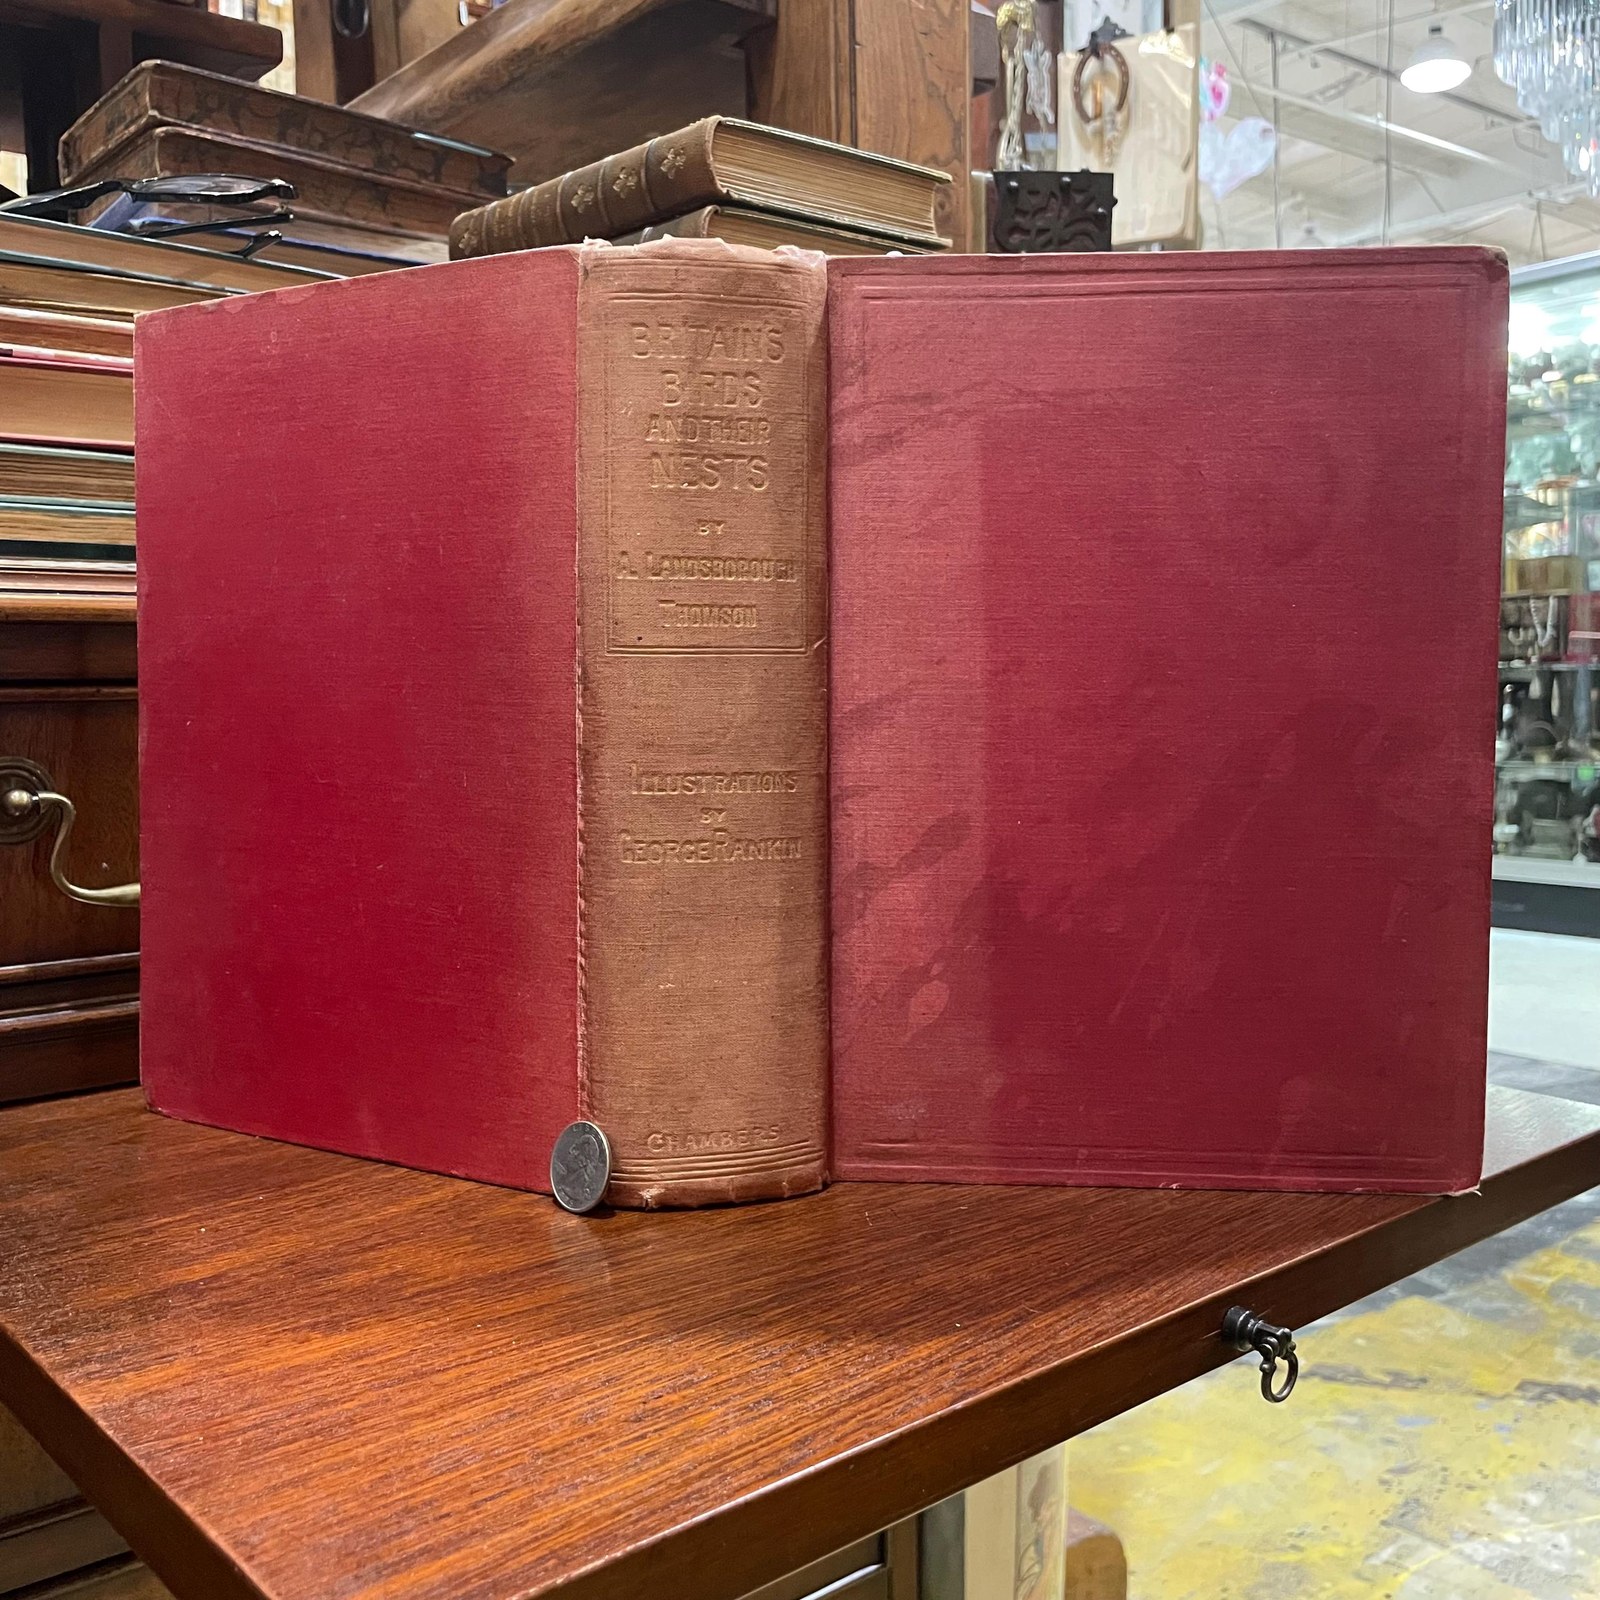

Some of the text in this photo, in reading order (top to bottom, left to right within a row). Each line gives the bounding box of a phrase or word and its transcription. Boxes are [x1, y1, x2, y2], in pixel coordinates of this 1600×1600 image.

[661, 368, 762, 408] BIRDS
[645, 414, 698, 442] AND
[649, 451, 769, 491] NESTS
[697, 518, 725, 536] BY
[658, 599, 758, 628] THOMSON
[629, 761, 798, 795] ILLUSTRATIONS
[700, 806, 728, 824] BY
[619, 827, 802, 864] GEORGE RANKIN
[647, 1124, 781, 1152] CHAMBERS
